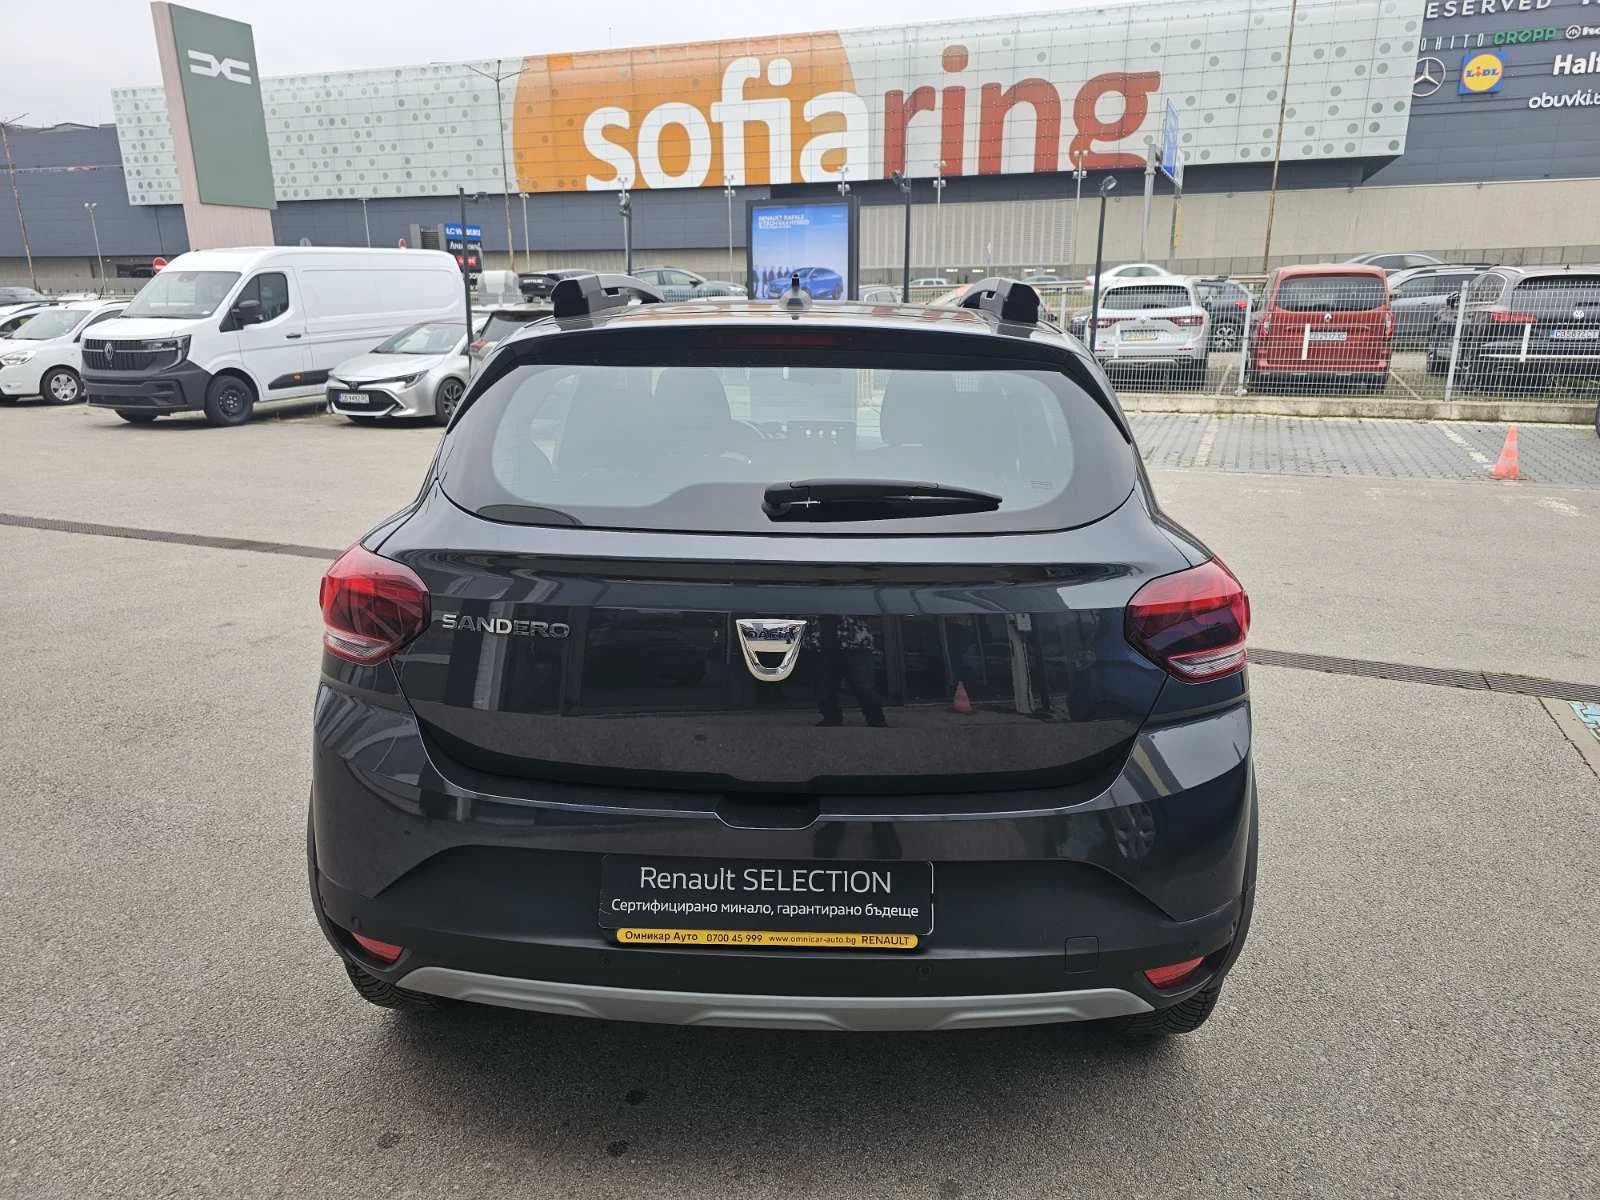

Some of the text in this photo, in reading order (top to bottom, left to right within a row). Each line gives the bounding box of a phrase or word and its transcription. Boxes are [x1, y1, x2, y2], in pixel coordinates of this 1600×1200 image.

[1494, 27, 1557, 45] CROPP
[441, 613, 570, 638] SANDERO
[640, 866, 891, 893] Renault SELECTION
[611, 898, 919, 918] Сертифицирано минало, гарантирано бъдеще
[625, 930, 910, 946] Омникар Ауто 0700 45 999 www.omnicar-auto.bg RENAULT
